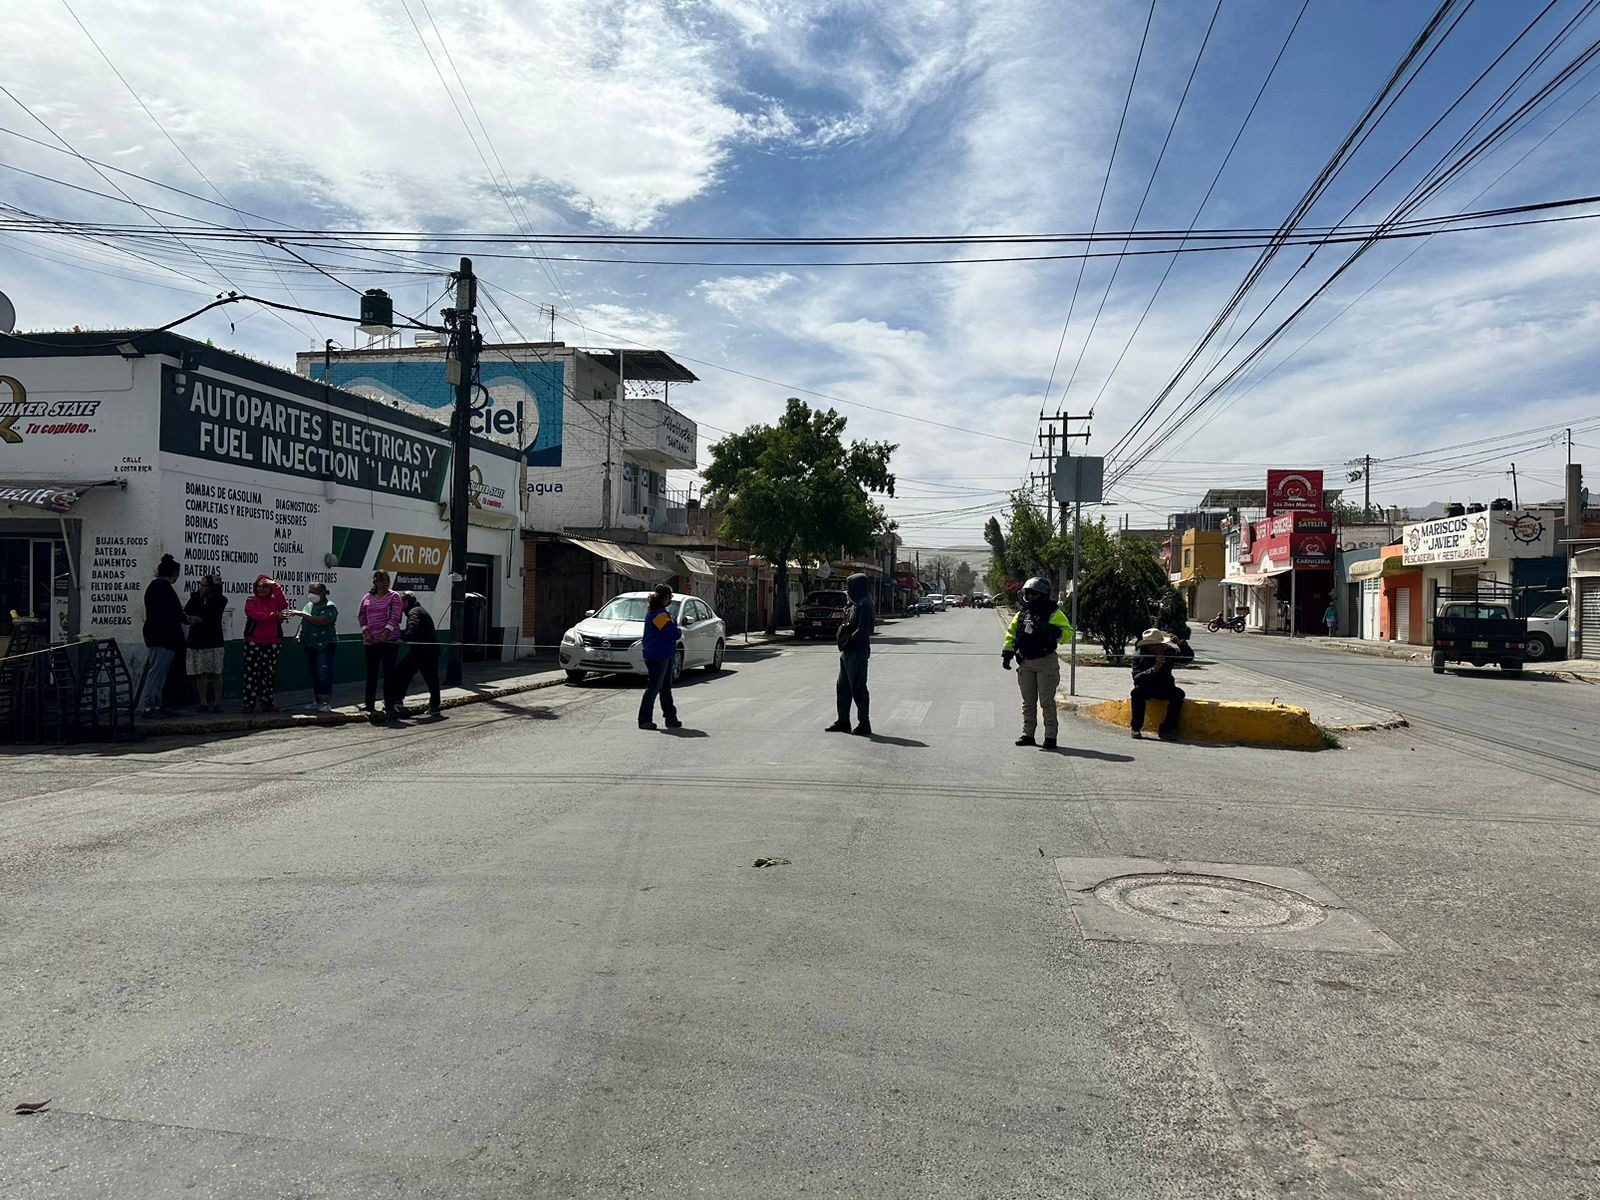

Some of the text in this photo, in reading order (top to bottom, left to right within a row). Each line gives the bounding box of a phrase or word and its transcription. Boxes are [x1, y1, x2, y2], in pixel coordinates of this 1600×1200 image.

[48, 401, 101, 417] STATE
[469, 397, 523, 434] ciel
[26, 423, 41, 434] Tu
[41, 422, 90, 435] copiloto
[190, 382, 437, 469] AUTOPARTES ELECTRICAS Y
[201, 422, 253, 461] FUEL
[262, 436, 359, 481] INJECTION
[185, 482, 262, 505] BOMBAS DE GASOLINA
[527, 483, 563, 496] agua
[185, 499, 274, 520] COMPLETAS Y REPUESTOS
[275, 498, 320, 513] DIAGNOSTICOS:
[185, 514, 218, 530] BOBINAS
[275, 513, 307, 526] SENSORES
[274, 528, 292, 539] MAP
[1421, 518, 1467, 538] MARISCOS
[184, 531, 229, 547] INYECTORES
[94, 547, 127, 556] BATERIA
[273, 540, 304, 554] CIGUEÑAL
[184, 548, 259, 564] MODULOS ENCENDIDO
[272, 556, 287, 567] TPS
[391, 544, 441, 566] XTR PRO
[1405, 547, 1486, 564] PESCADERIA Y RESTAURANTE
[93, 558, 137, 568] AUMENTOS
[92, 570, 125, 579] BANDAS
[184, 564, 221, 577] BATERIAS
[272, 570, 338, 583] LAVADO DE INYECTORES
[91, 582, 140, 591] FILTRO DE AIRE
[91, 594, 128, 602] GASOLINA
[92, 605, 127, 614] ADITIVOS
[91, 617, 132, 625] MANGERAS
